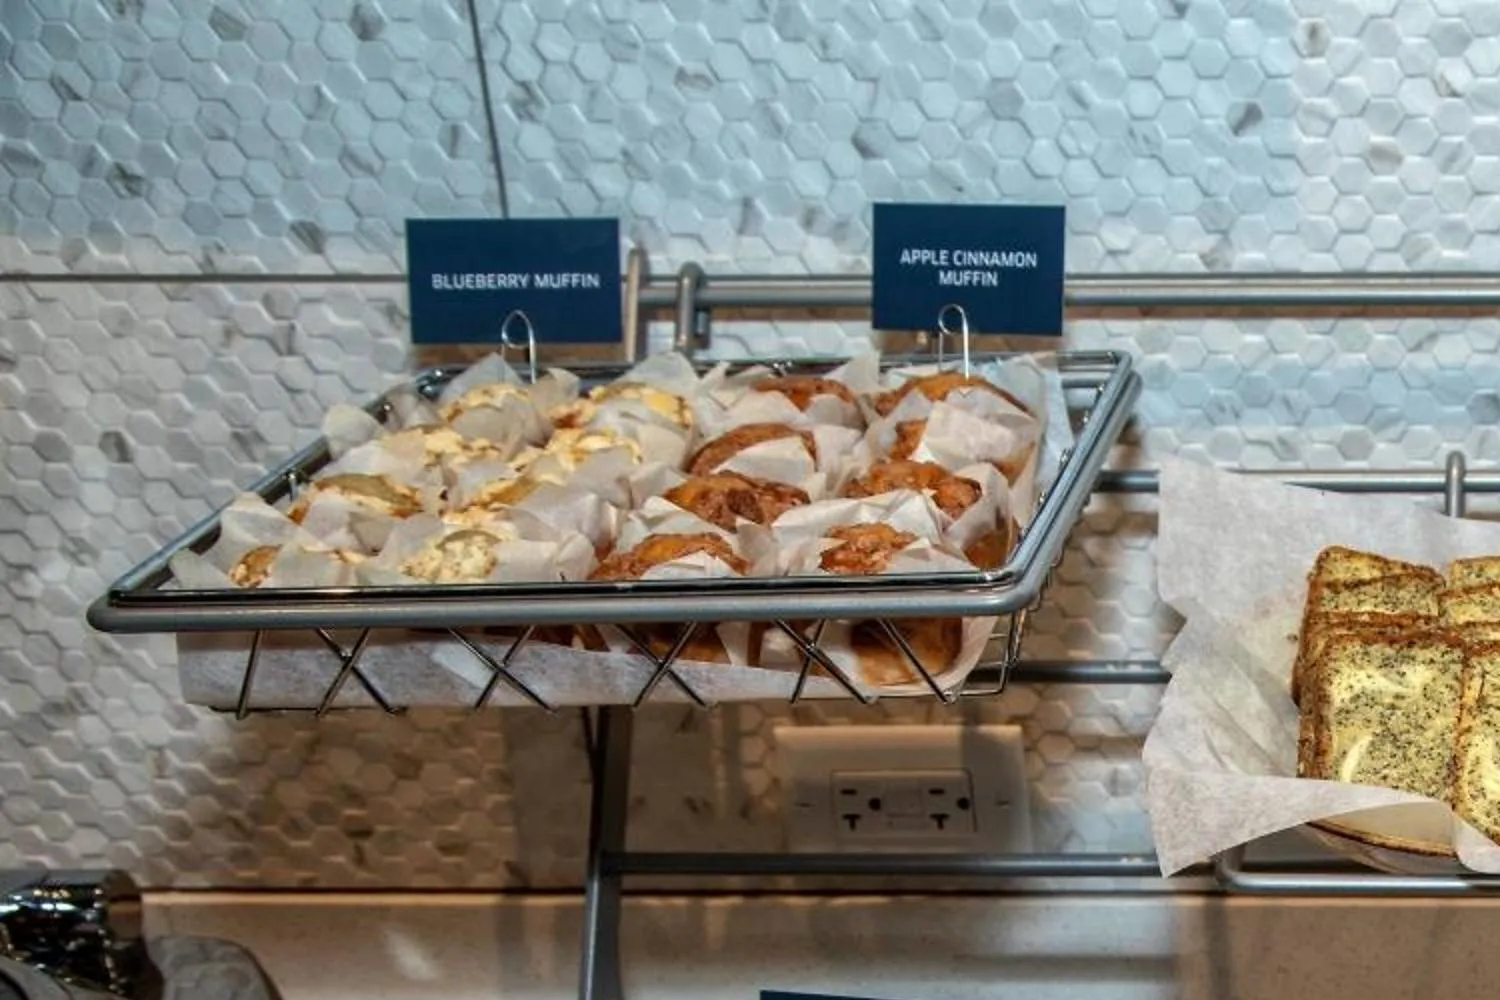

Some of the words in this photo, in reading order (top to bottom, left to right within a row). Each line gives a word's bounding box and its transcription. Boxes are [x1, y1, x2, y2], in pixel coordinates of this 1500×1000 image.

[900, 249, 948, 265] APPLE
[953, 250, 1037, 267] CINNAMON
[432, 273, 529, 289] BLUEBERRY
[534, 273, 600, 288] MUFFIN
[939, 270, 998, 286] MUFFIN
